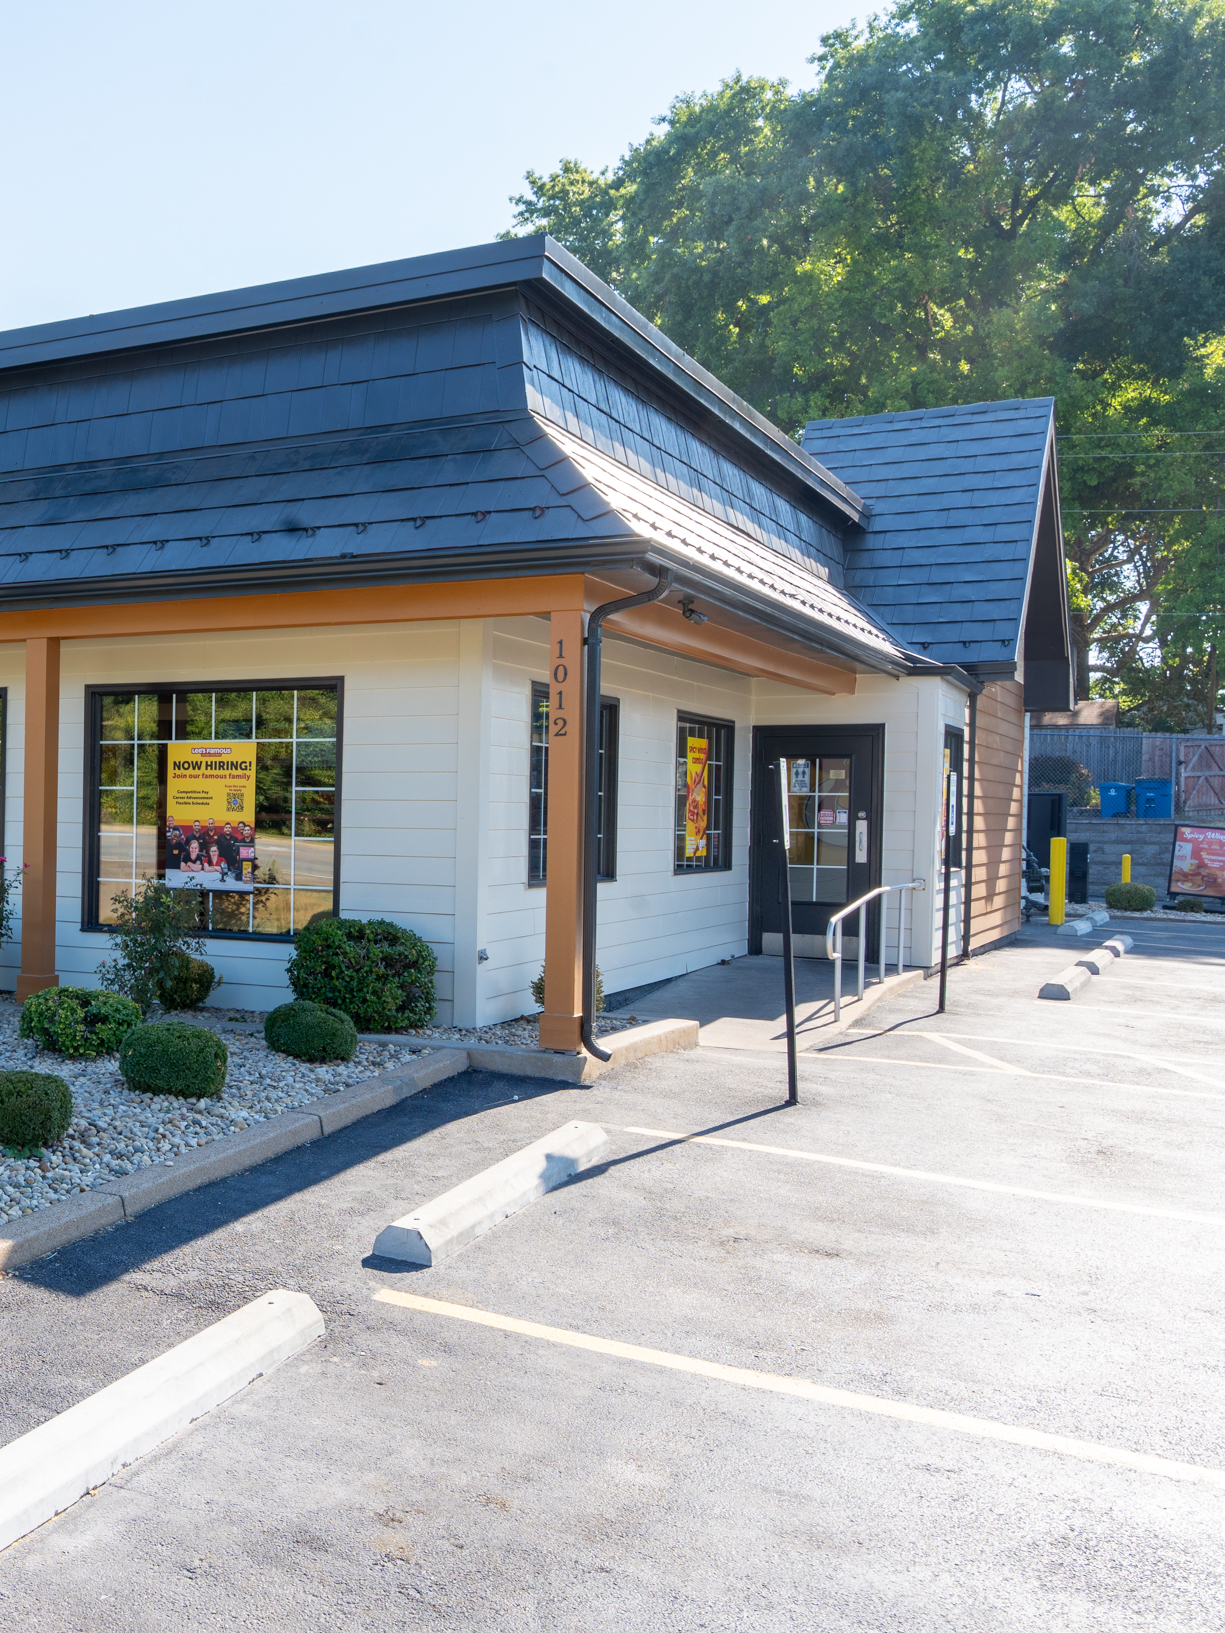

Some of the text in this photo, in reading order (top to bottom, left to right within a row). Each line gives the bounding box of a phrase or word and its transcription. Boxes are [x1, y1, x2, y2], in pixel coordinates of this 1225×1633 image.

[553, 638, 568, 737] 1012
[173, 761, 252, 771] NOW HIRING!
[229, 773, 250, 781] family
[1184, 831, 1204, 841] Spicy
